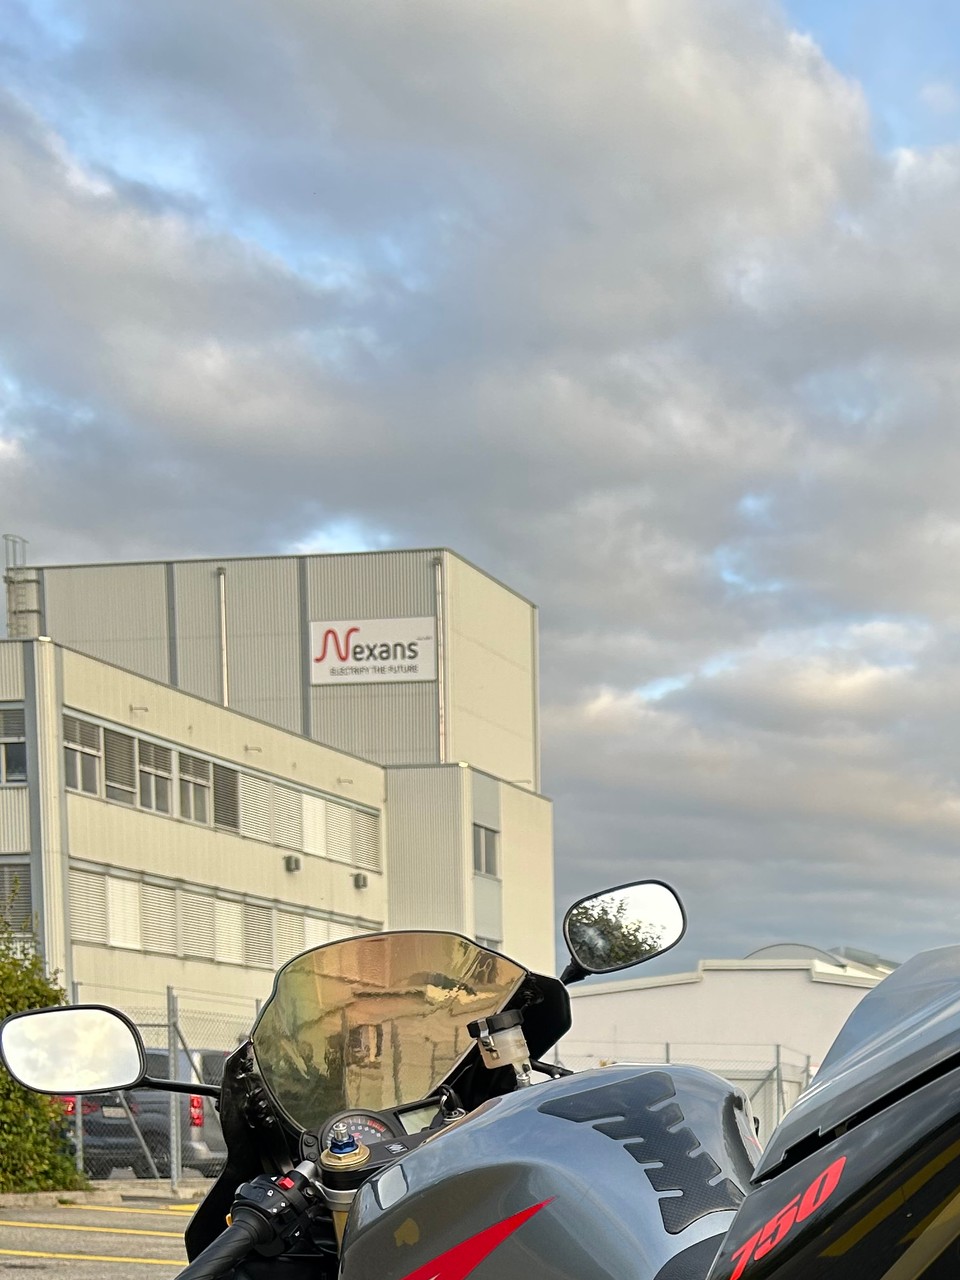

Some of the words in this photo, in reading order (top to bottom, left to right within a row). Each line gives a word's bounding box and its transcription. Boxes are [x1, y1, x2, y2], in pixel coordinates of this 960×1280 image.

[314, 626, 420, 663] Nexans
[330, 665, 370, 677] ELECTRIFY
[371, 665, 386, 675] THE
[388, 664, 419, 674] FUTURE
